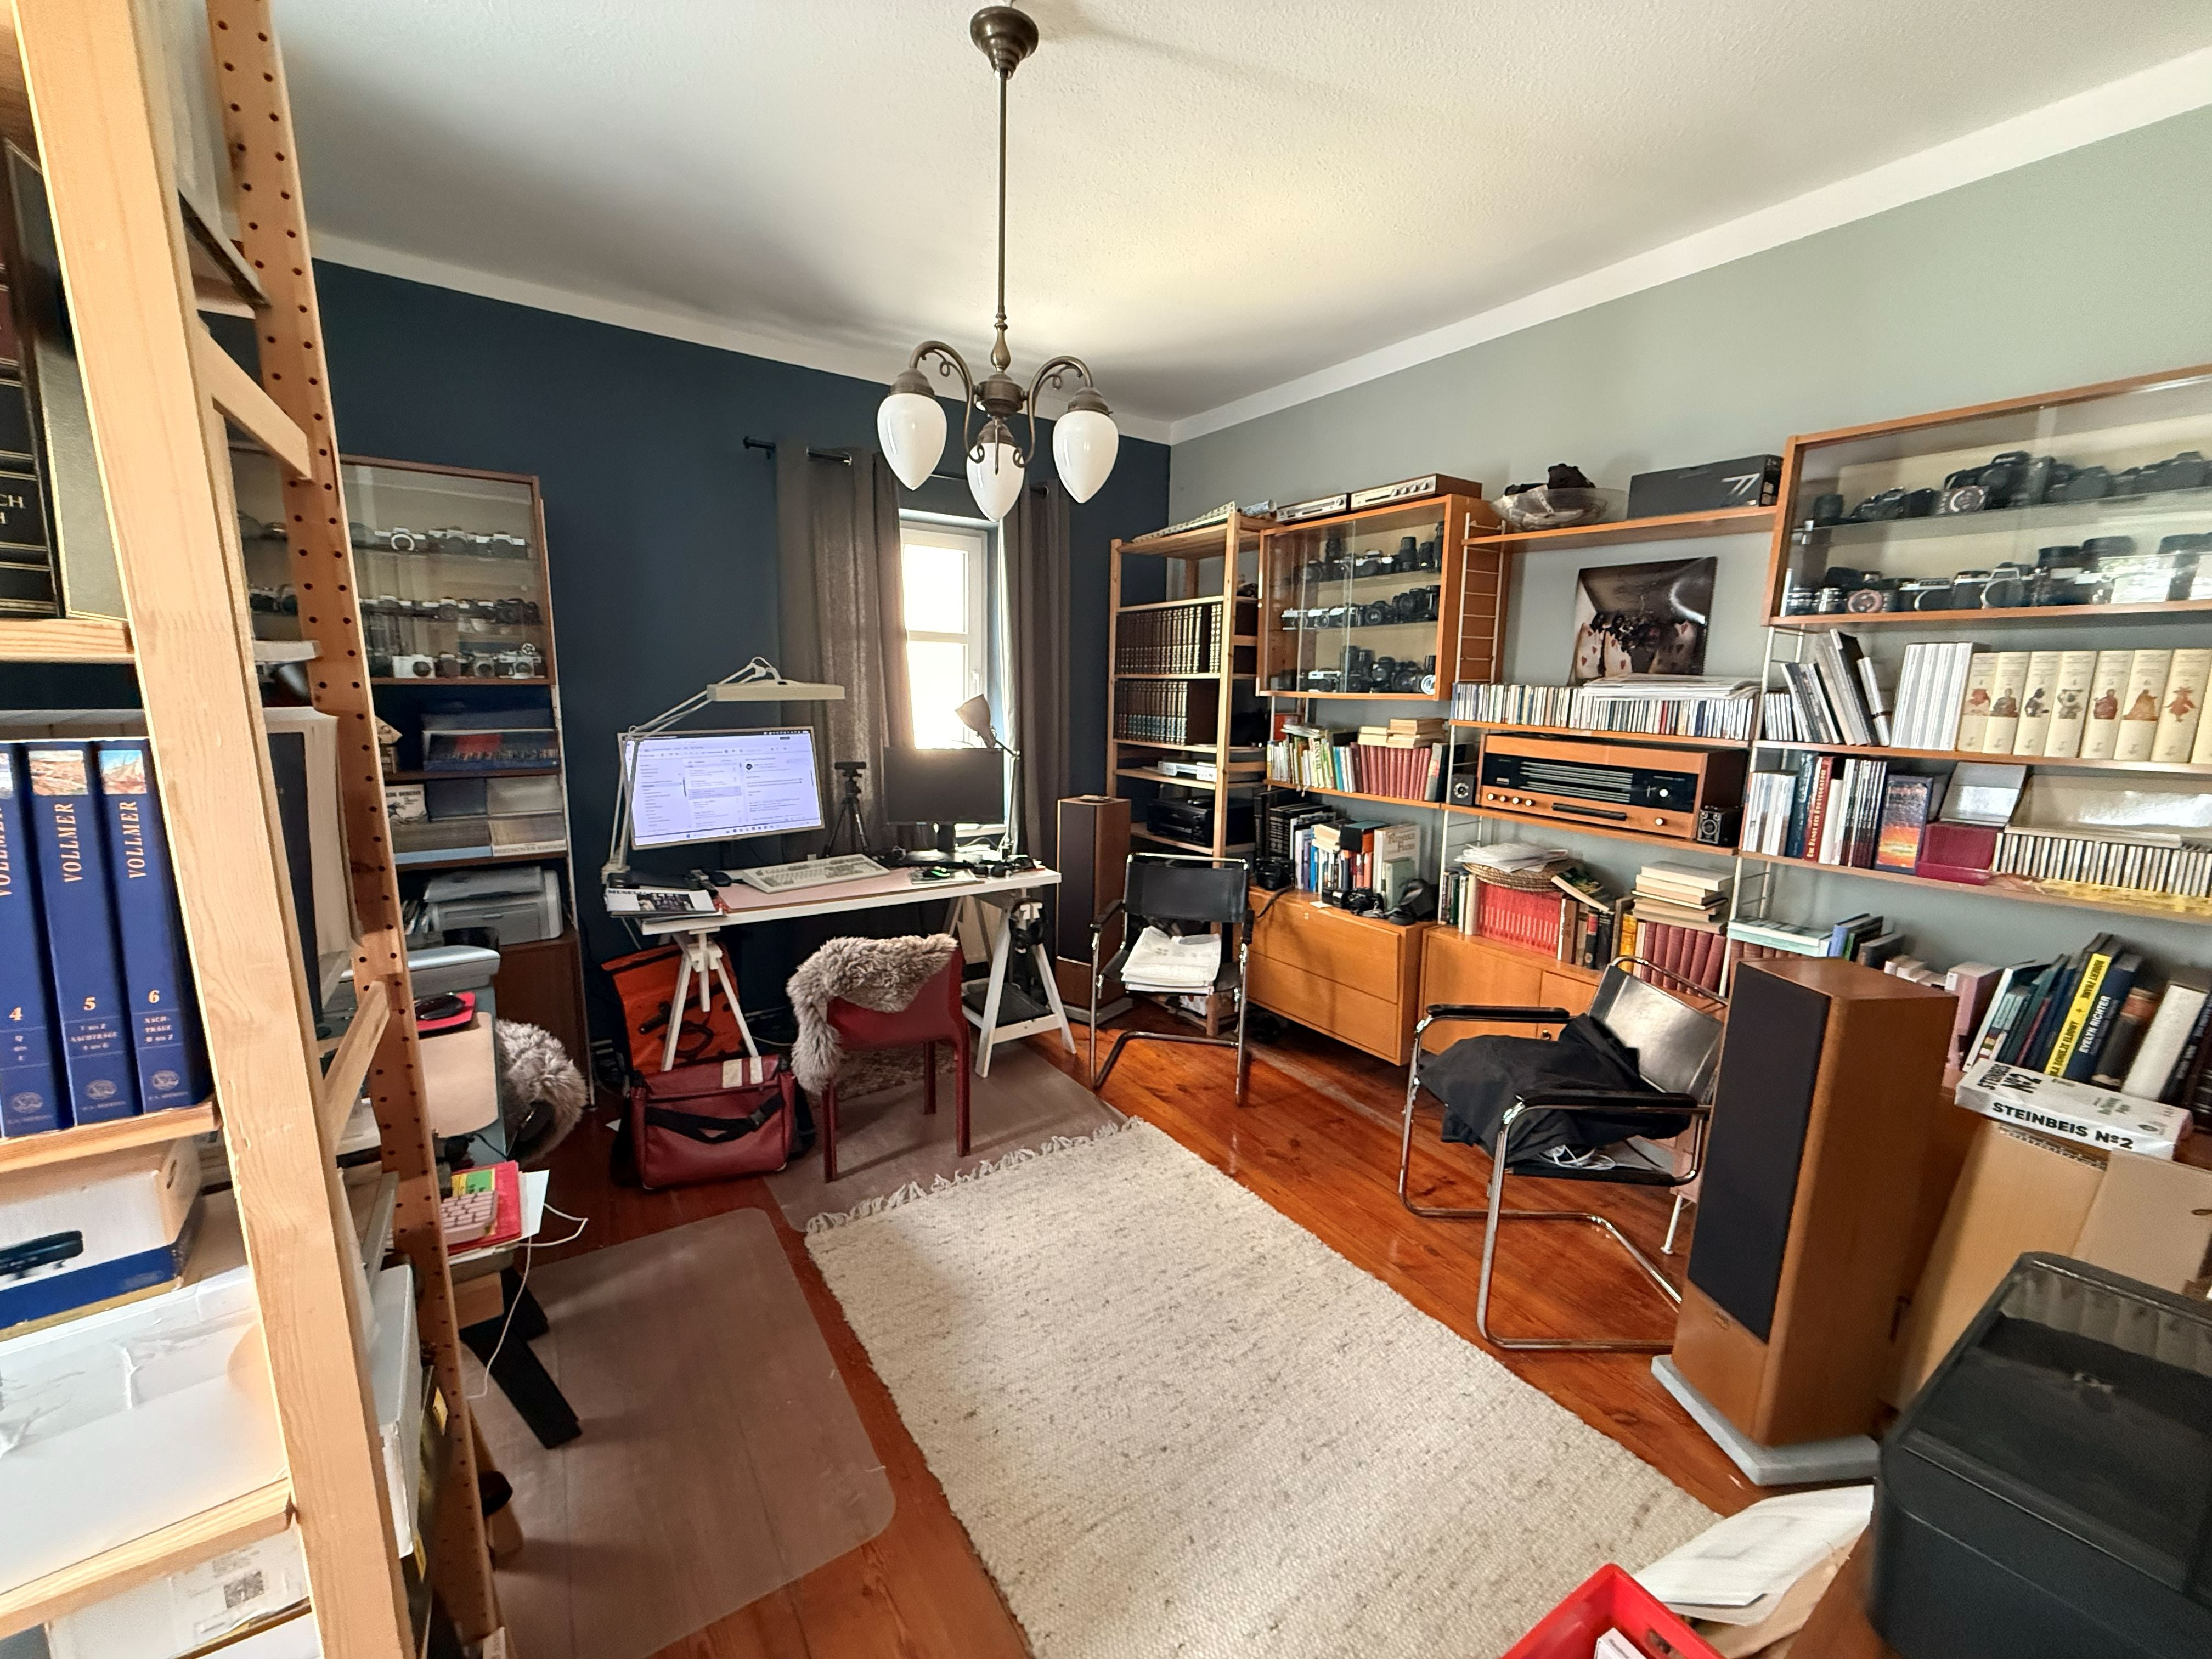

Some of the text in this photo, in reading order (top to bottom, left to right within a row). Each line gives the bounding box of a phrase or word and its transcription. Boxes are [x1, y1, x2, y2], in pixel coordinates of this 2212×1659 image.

[55, 803, 83, 883] VOLLMER
[119, 801, 147, 878] VOLLMER
[83, 996, 96, 1011] 5
[148, 990, 160, 1003] 6
[9, 1007, 22, 1022] 4
[2078, 1026, 2098, 1054] EVELYN
[2090, 995, 2112, 1028] RICHTER
[1992, 1102, 2089, 1137] STEINBEIS
